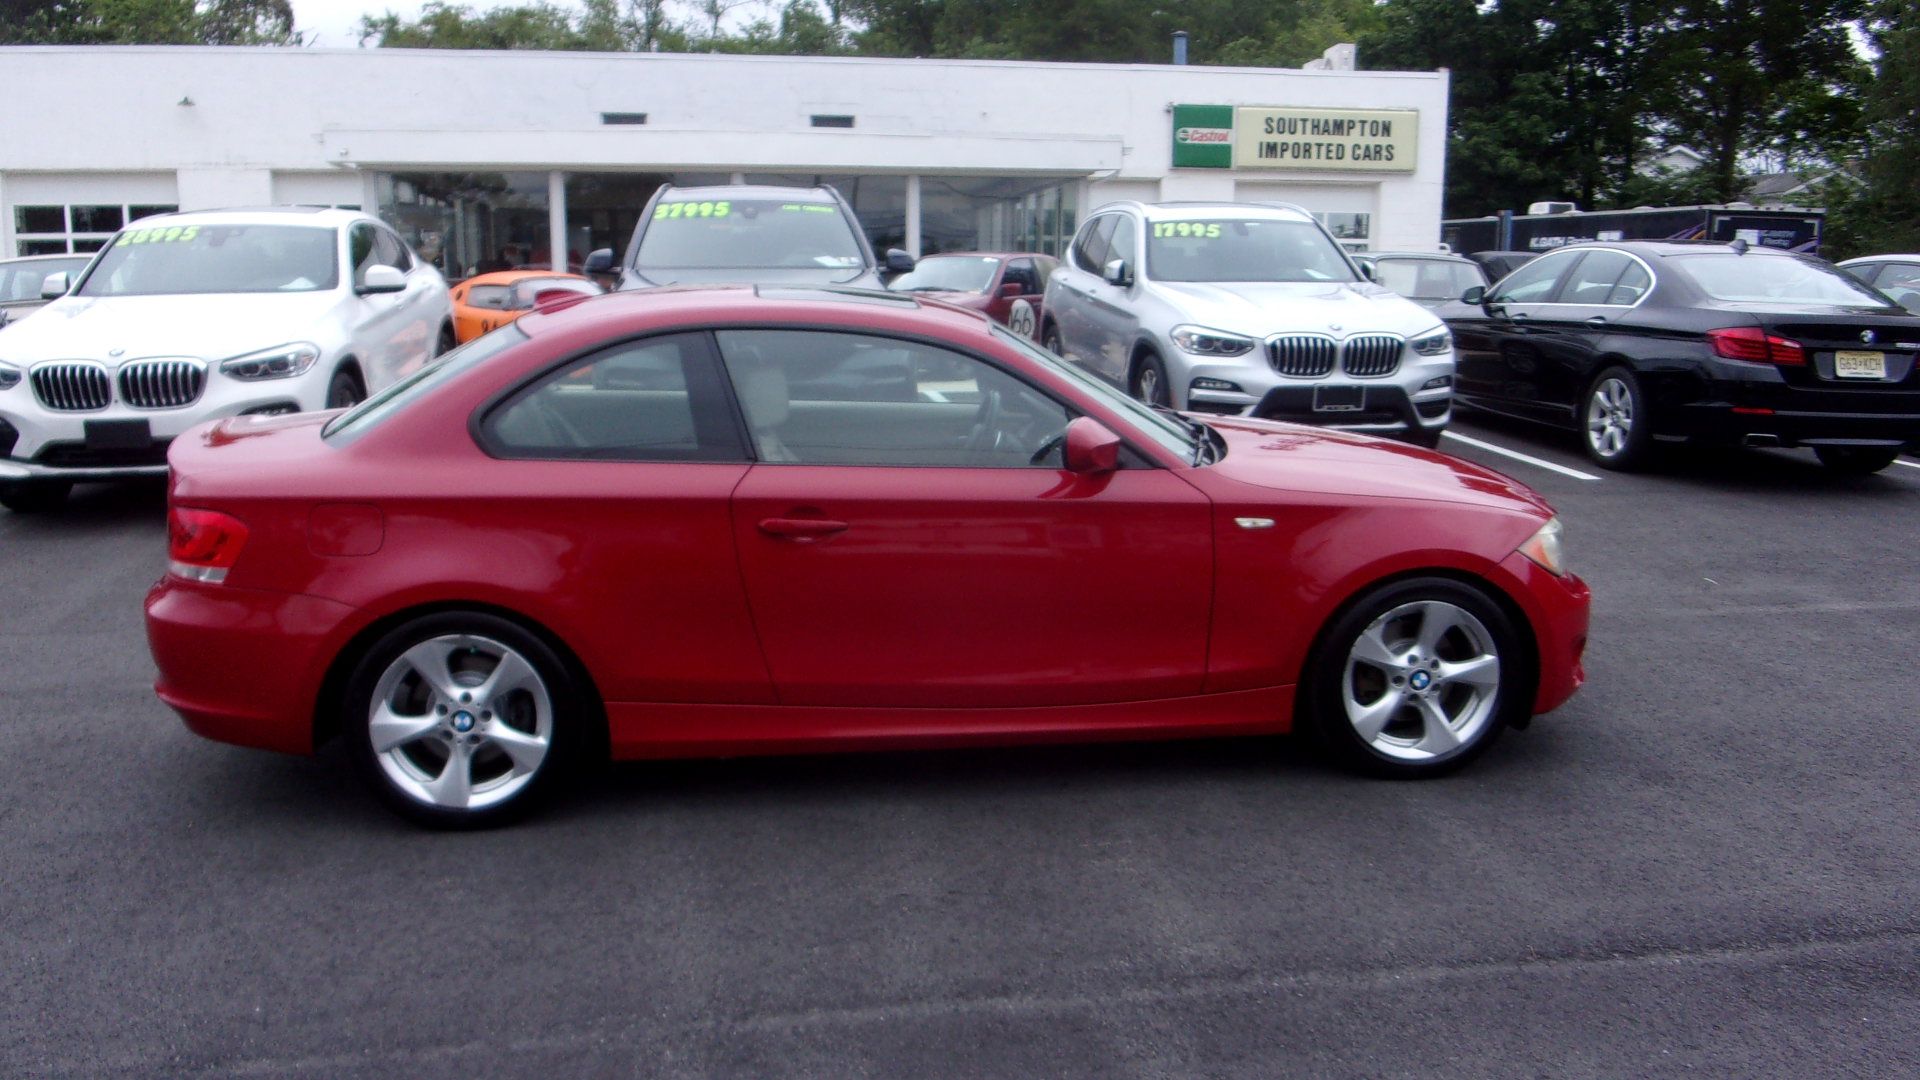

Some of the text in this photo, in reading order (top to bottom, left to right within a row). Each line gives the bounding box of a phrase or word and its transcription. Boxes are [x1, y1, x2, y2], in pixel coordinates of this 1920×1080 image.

[1189, 128, 1229, 142] Castrol
[1264, 117, 1392, 138] SOUTHAMPTON
[1258, 141, 1395, 162] IMPORTED CARS
[653, 201, 731, 219] 37995
[1153, 222, 1221, 239] 17995
